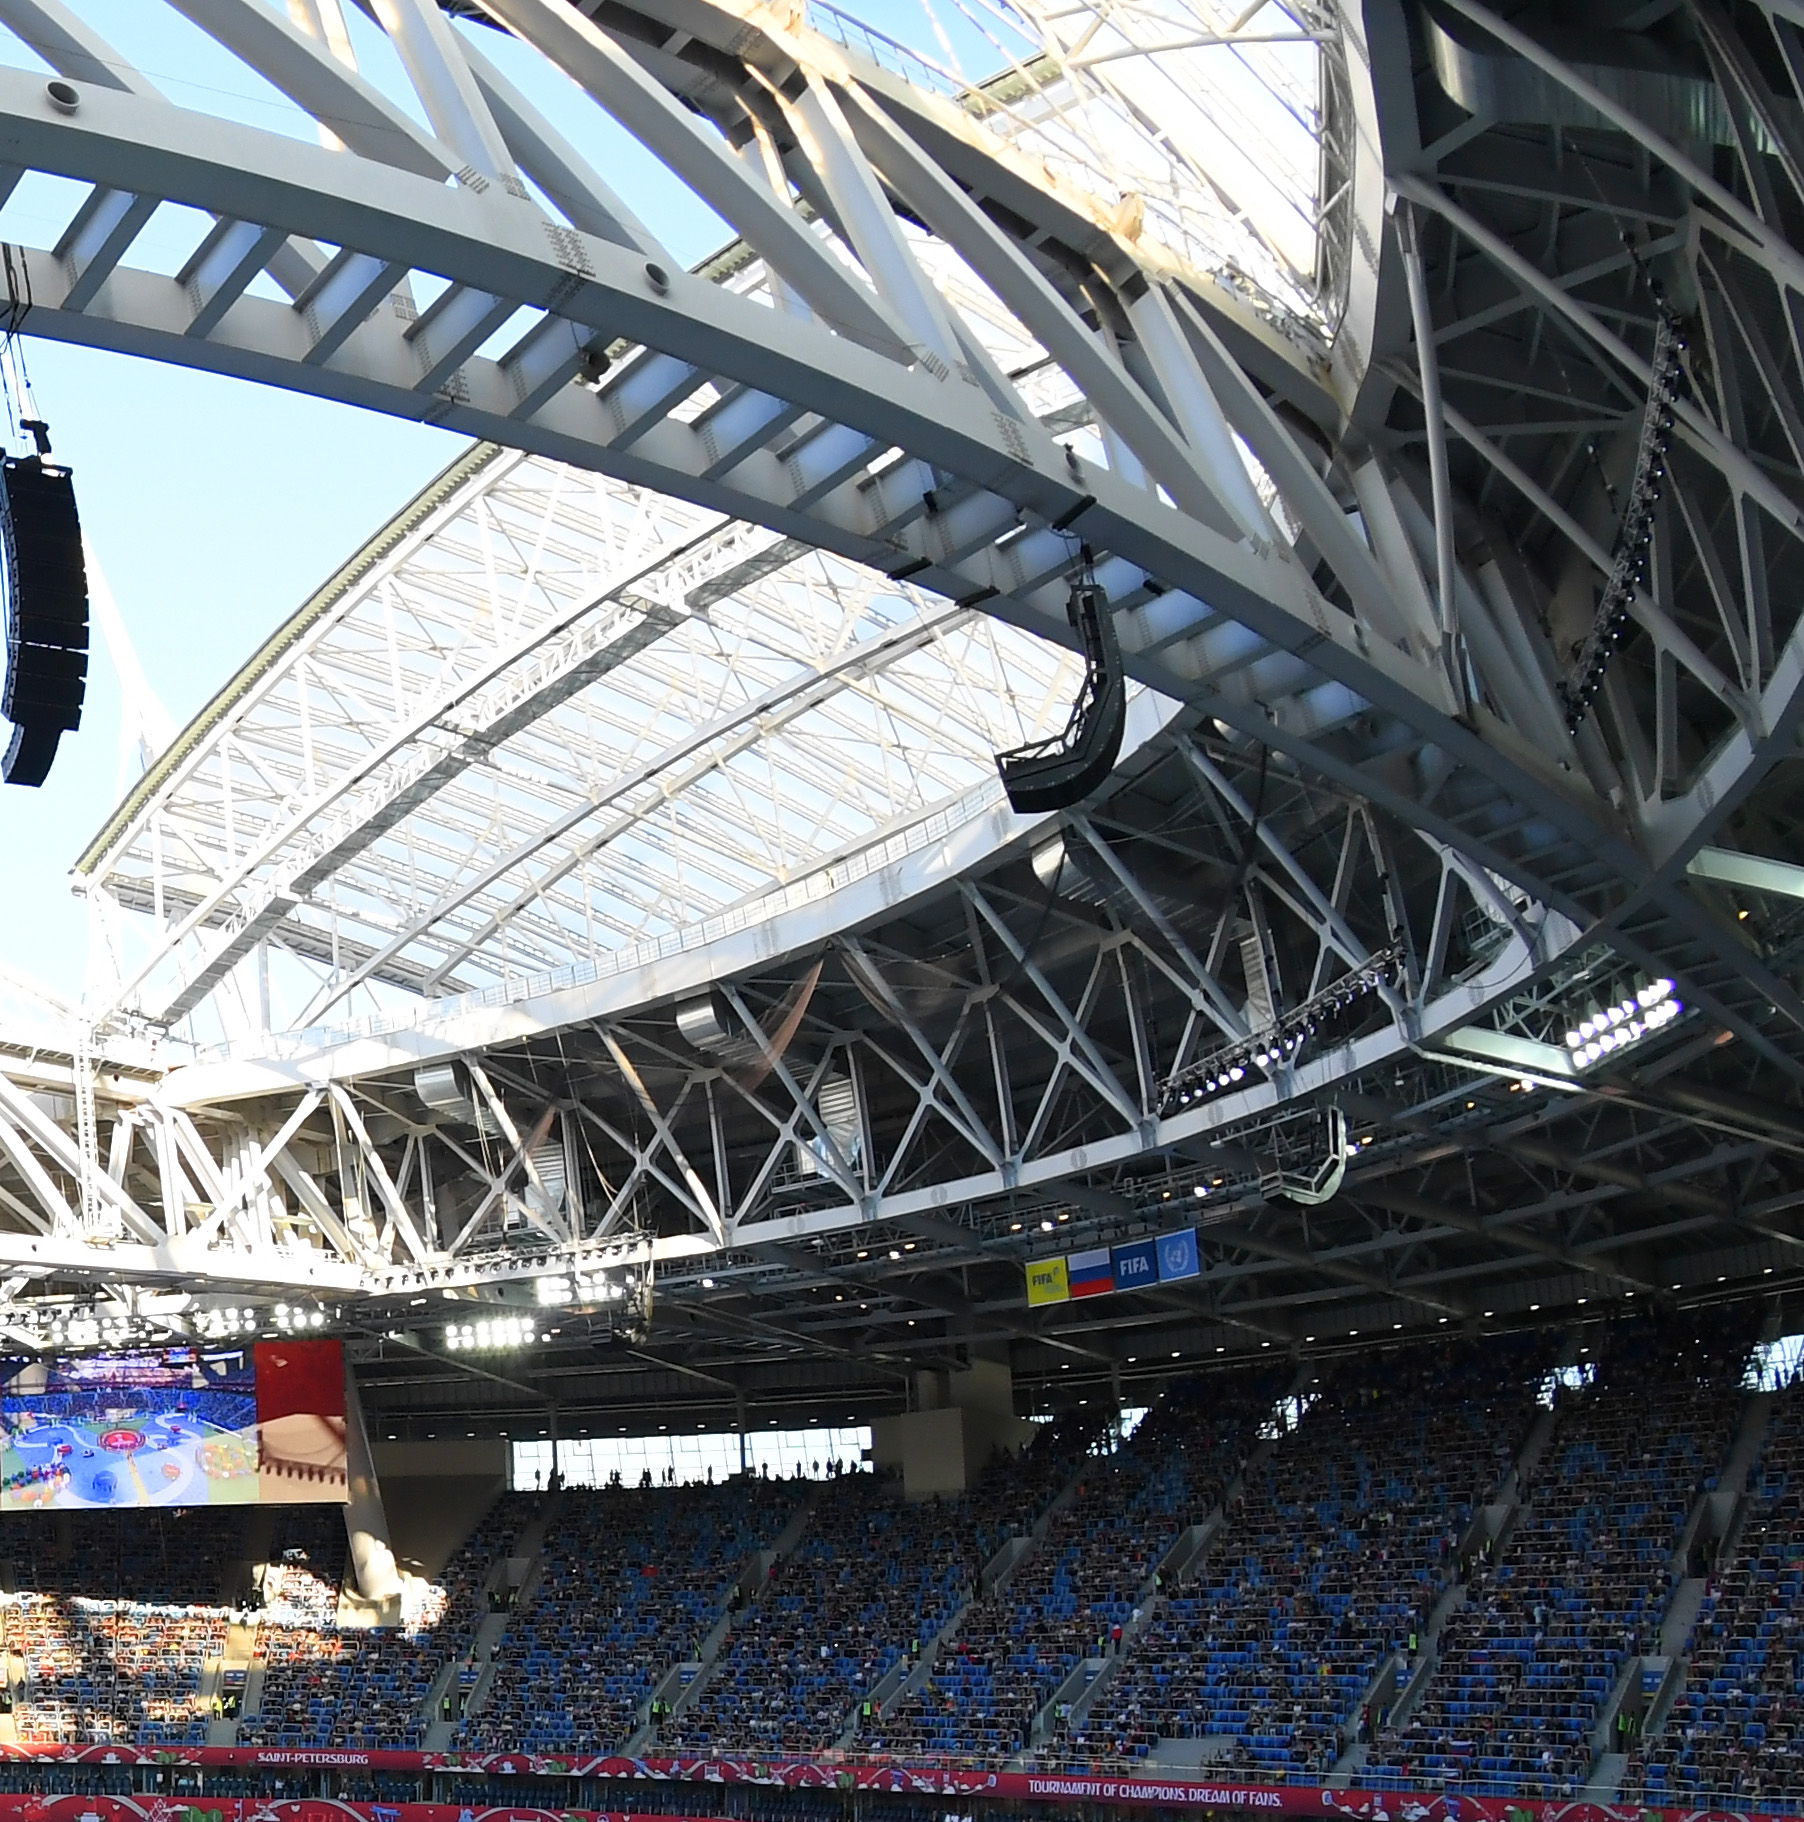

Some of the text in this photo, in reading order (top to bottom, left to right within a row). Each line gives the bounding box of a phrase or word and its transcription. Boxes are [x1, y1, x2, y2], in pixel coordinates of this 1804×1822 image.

[1118, 1256, 1149, 1277] FIFA
[1032, 1270, 1055, 1286] FIFA
[258, 1752, 369, 1765] SAINT-PETERSBURG
[1028, 1780, 1284, 1807] TOURNAMENT OF CHAMPIONS. DREAM OF FANS.
